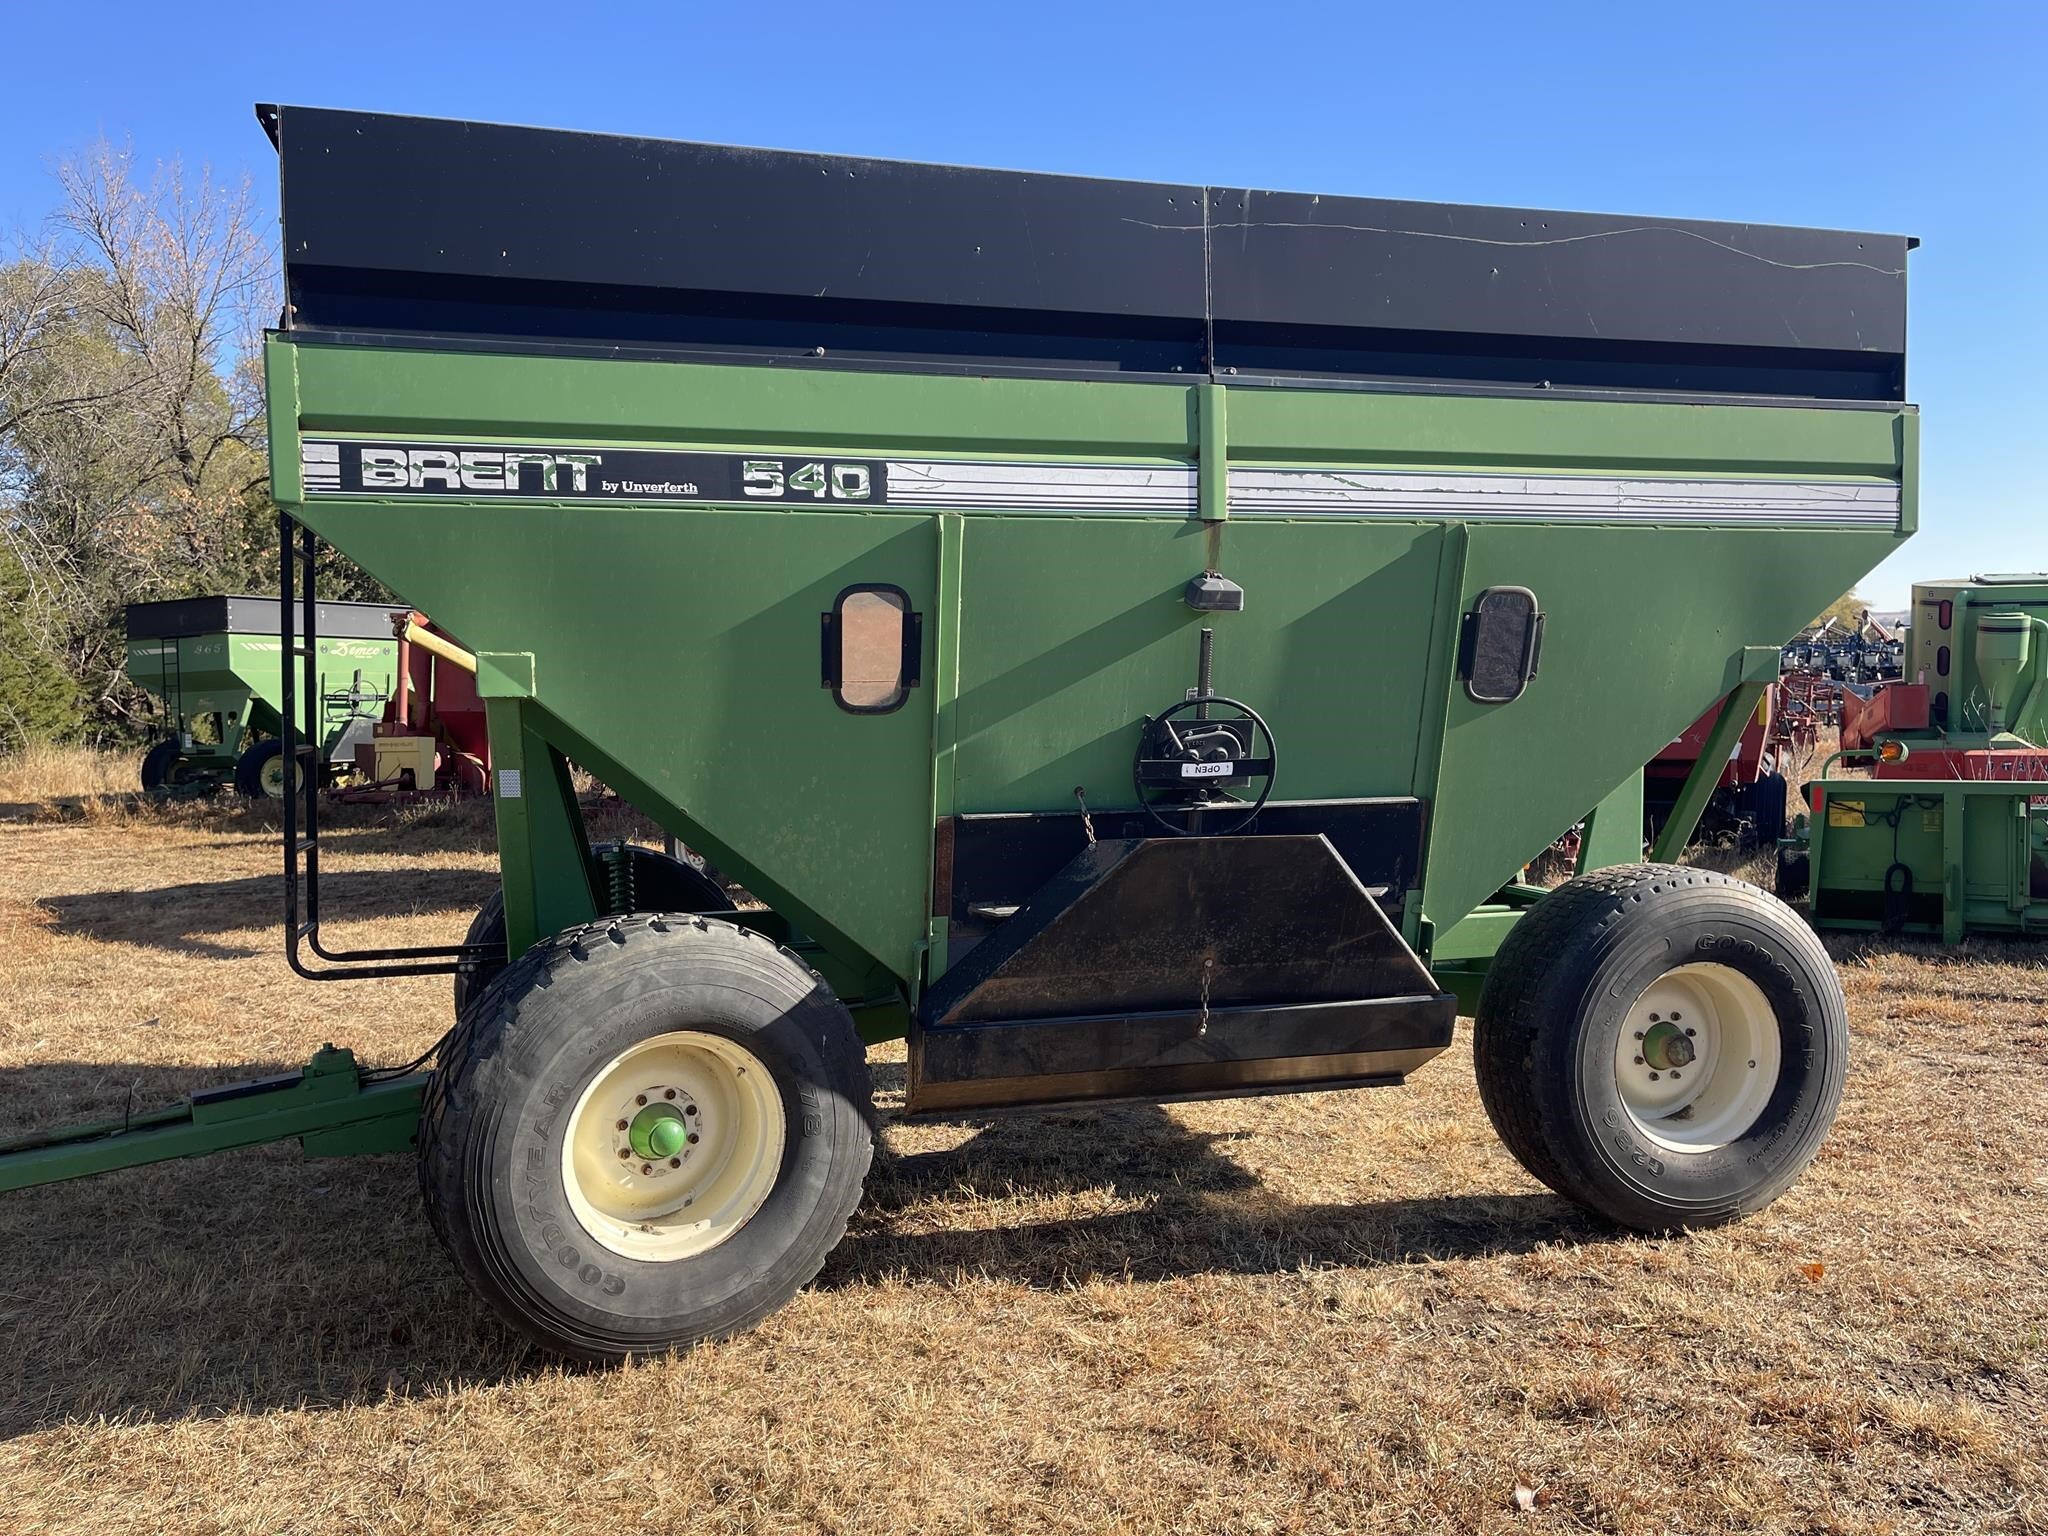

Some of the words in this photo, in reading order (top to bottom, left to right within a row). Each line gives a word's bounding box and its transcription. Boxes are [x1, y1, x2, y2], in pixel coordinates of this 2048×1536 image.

[361, 449, 601, 492] BRENT
[601, 480, 619, 493] by
[622, 481, 698, 494] Unverferth
[742, 459, 873, 500] 540
[1195, 765, 1220, 773] OPEN
[527, 1080, 626, 1297] GOODYEAR
